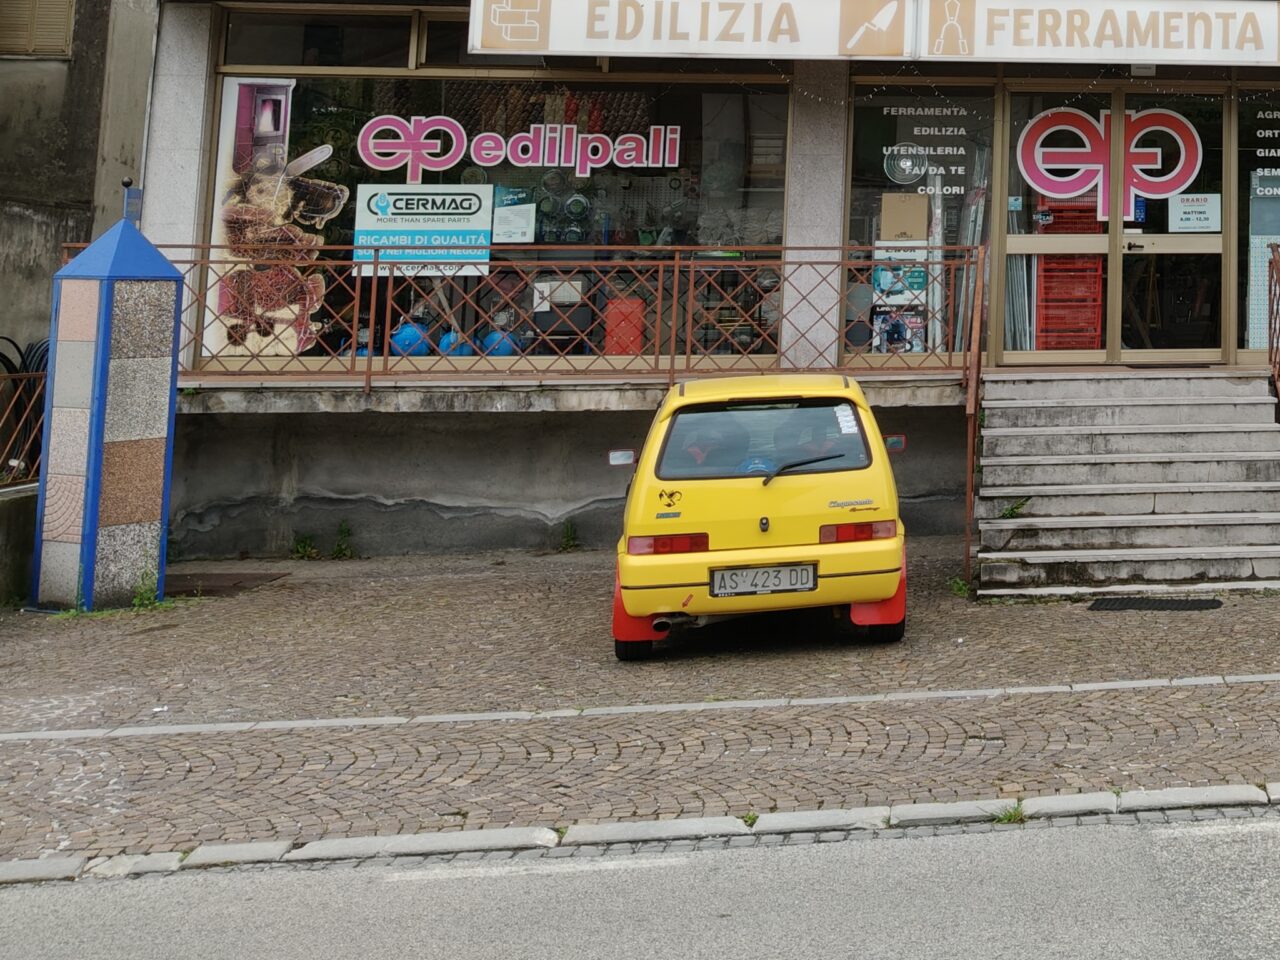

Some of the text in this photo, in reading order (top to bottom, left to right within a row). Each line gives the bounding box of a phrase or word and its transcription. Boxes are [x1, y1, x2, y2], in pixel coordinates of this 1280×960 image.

[985, 7, 1264, 51] FERRAMENTA
[883, 107, 967, 116] FERRAMENTA
[913, 127, 966, 136] EDILIZIA
[470, 124, 681, 178] edilpali
[882, 146, 966, 155] UTENSILERIA
[905, 166, 966, 175] FAI DA TE
[917, 186, 965, 195] COLORI
[393, 198, 473, 211] CERMAG
[358, 235, 412, 245] RICAMBI
[415, 235, 428, 245] DI
[718, 568, 810, 591] AS 423 DD
